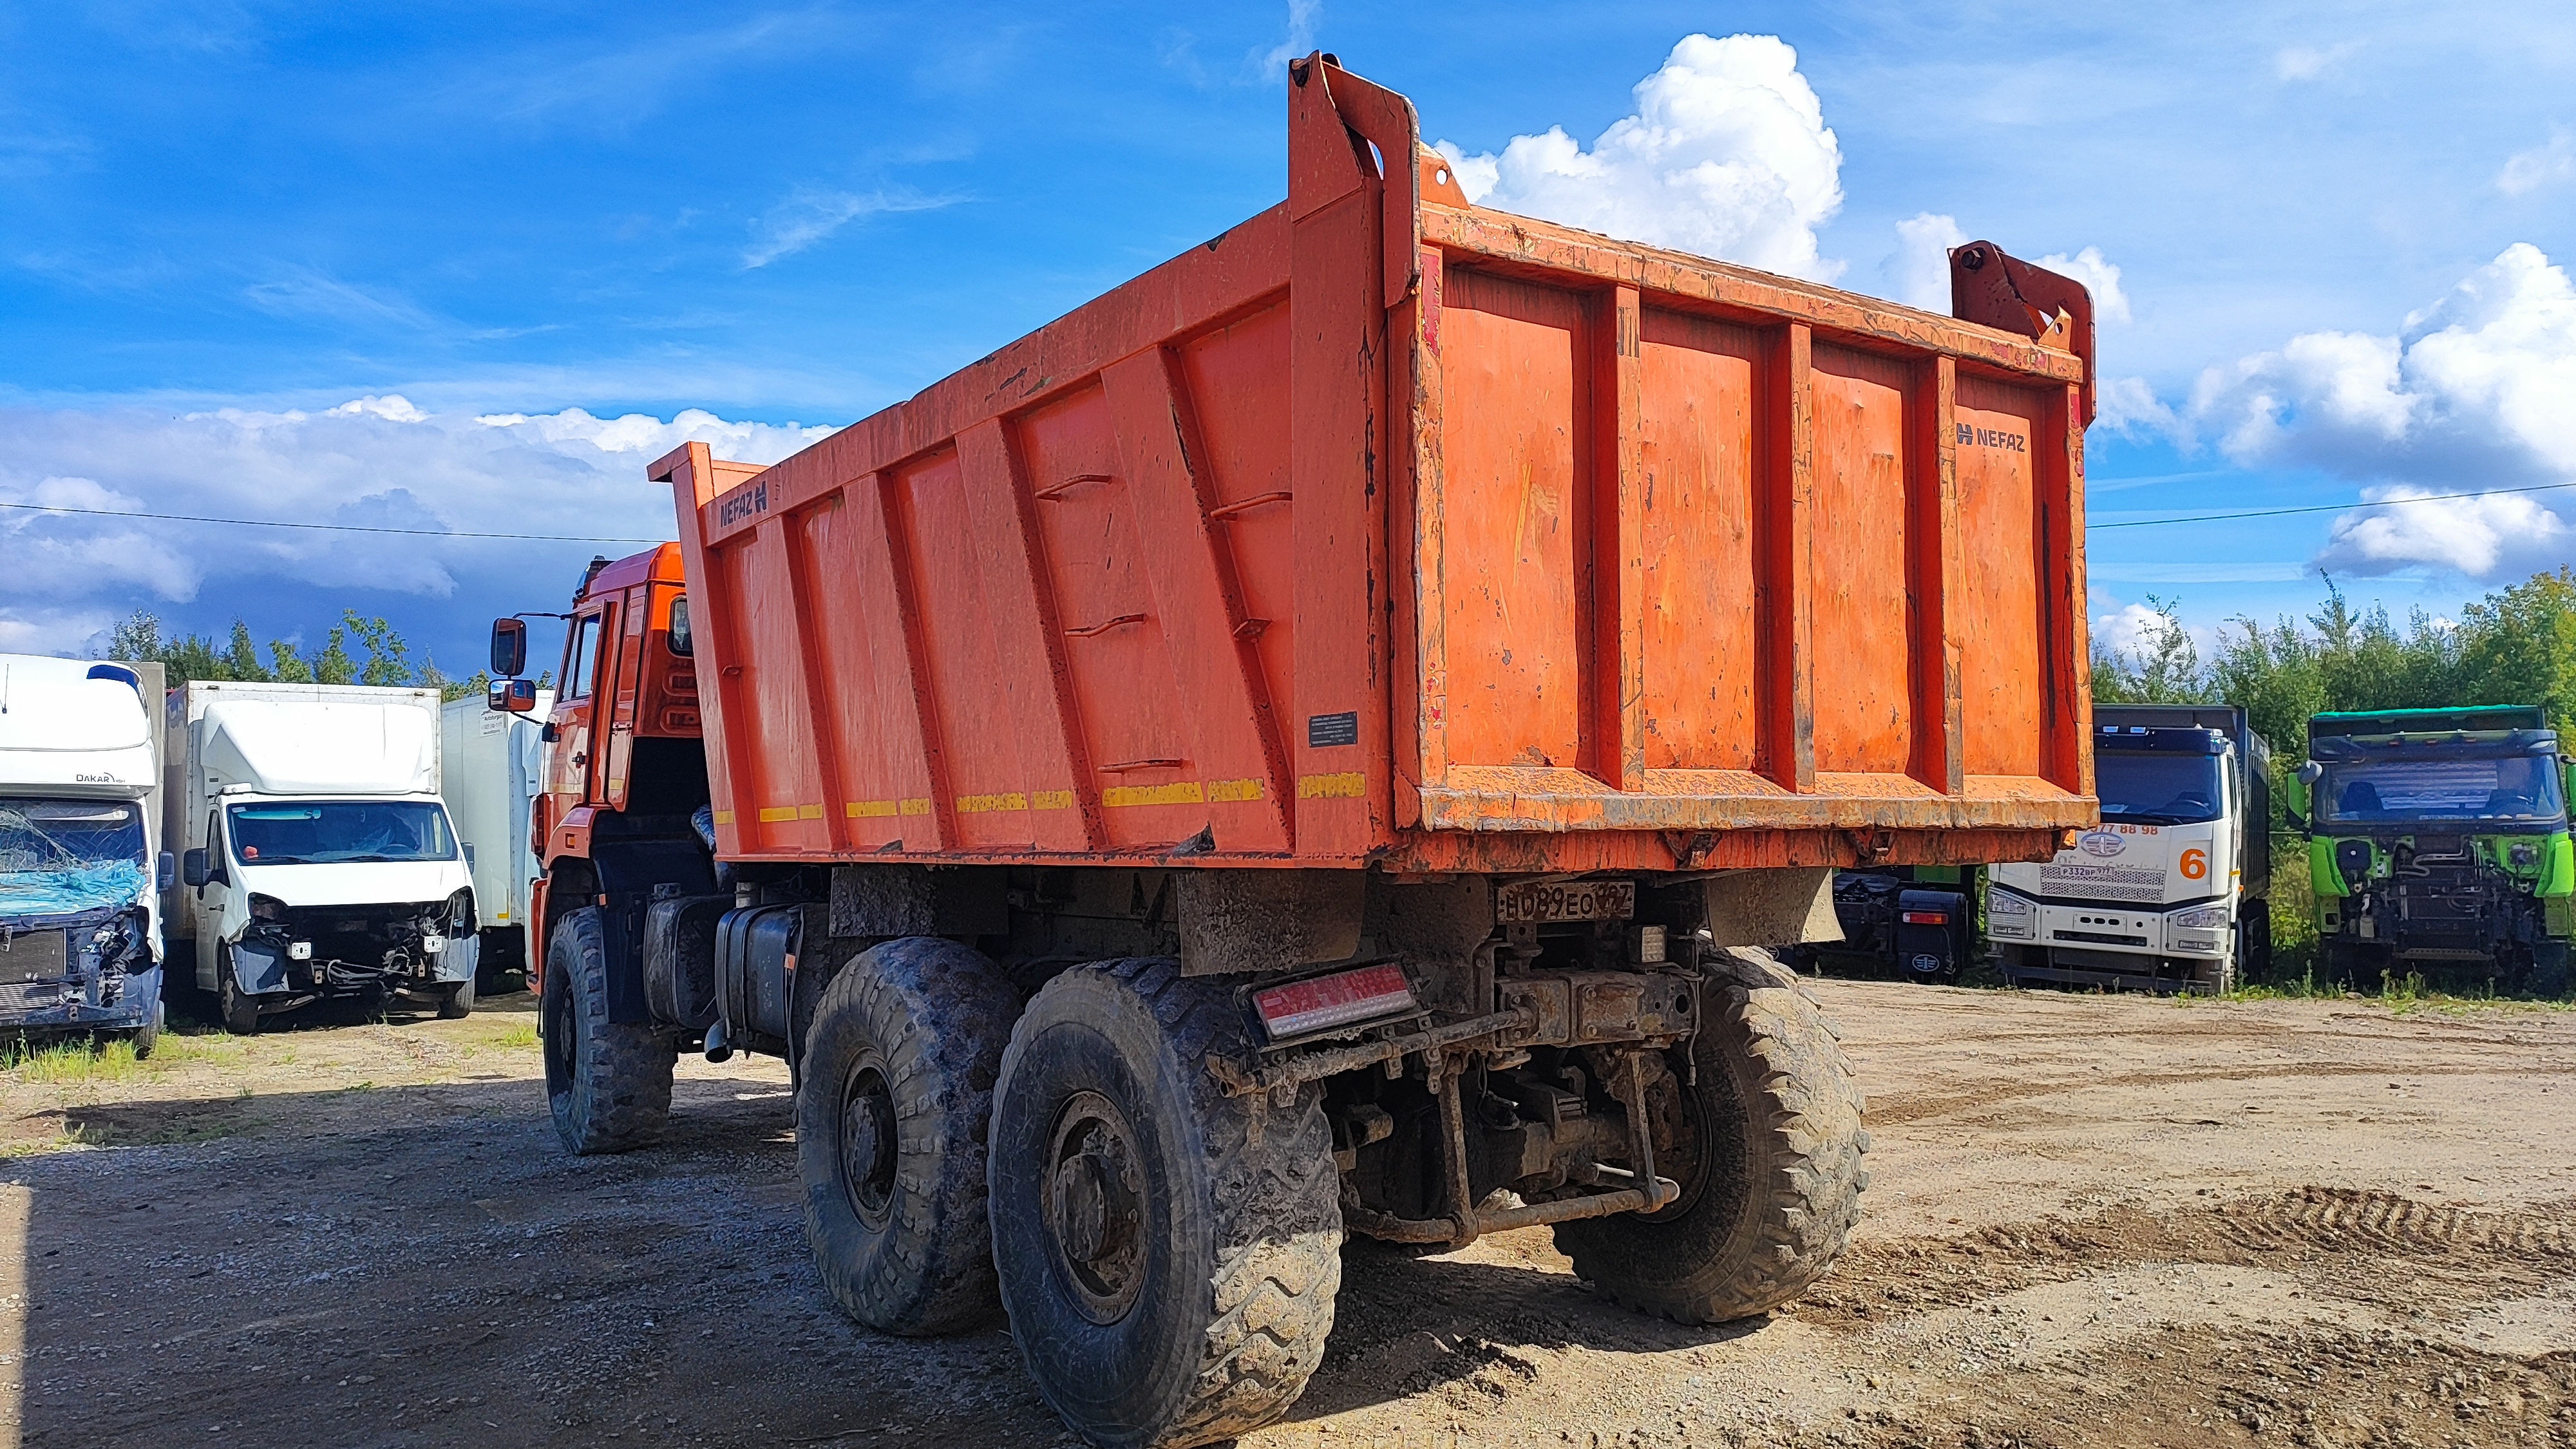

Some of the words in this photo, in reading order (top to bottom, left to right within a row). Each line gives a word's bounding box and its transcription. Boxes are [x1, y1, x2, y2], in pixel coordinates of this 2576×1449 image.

[1977, 428, 2025, 453] NEFAZ
[721, 491, 752, 527] NEFAZ
[77, 774, 109, 782] DAKAR
[2119, 825, 2136, 834] 88
[2141, 825, 2158, 835] 98
[2180, 849, 2206, 880] 6
